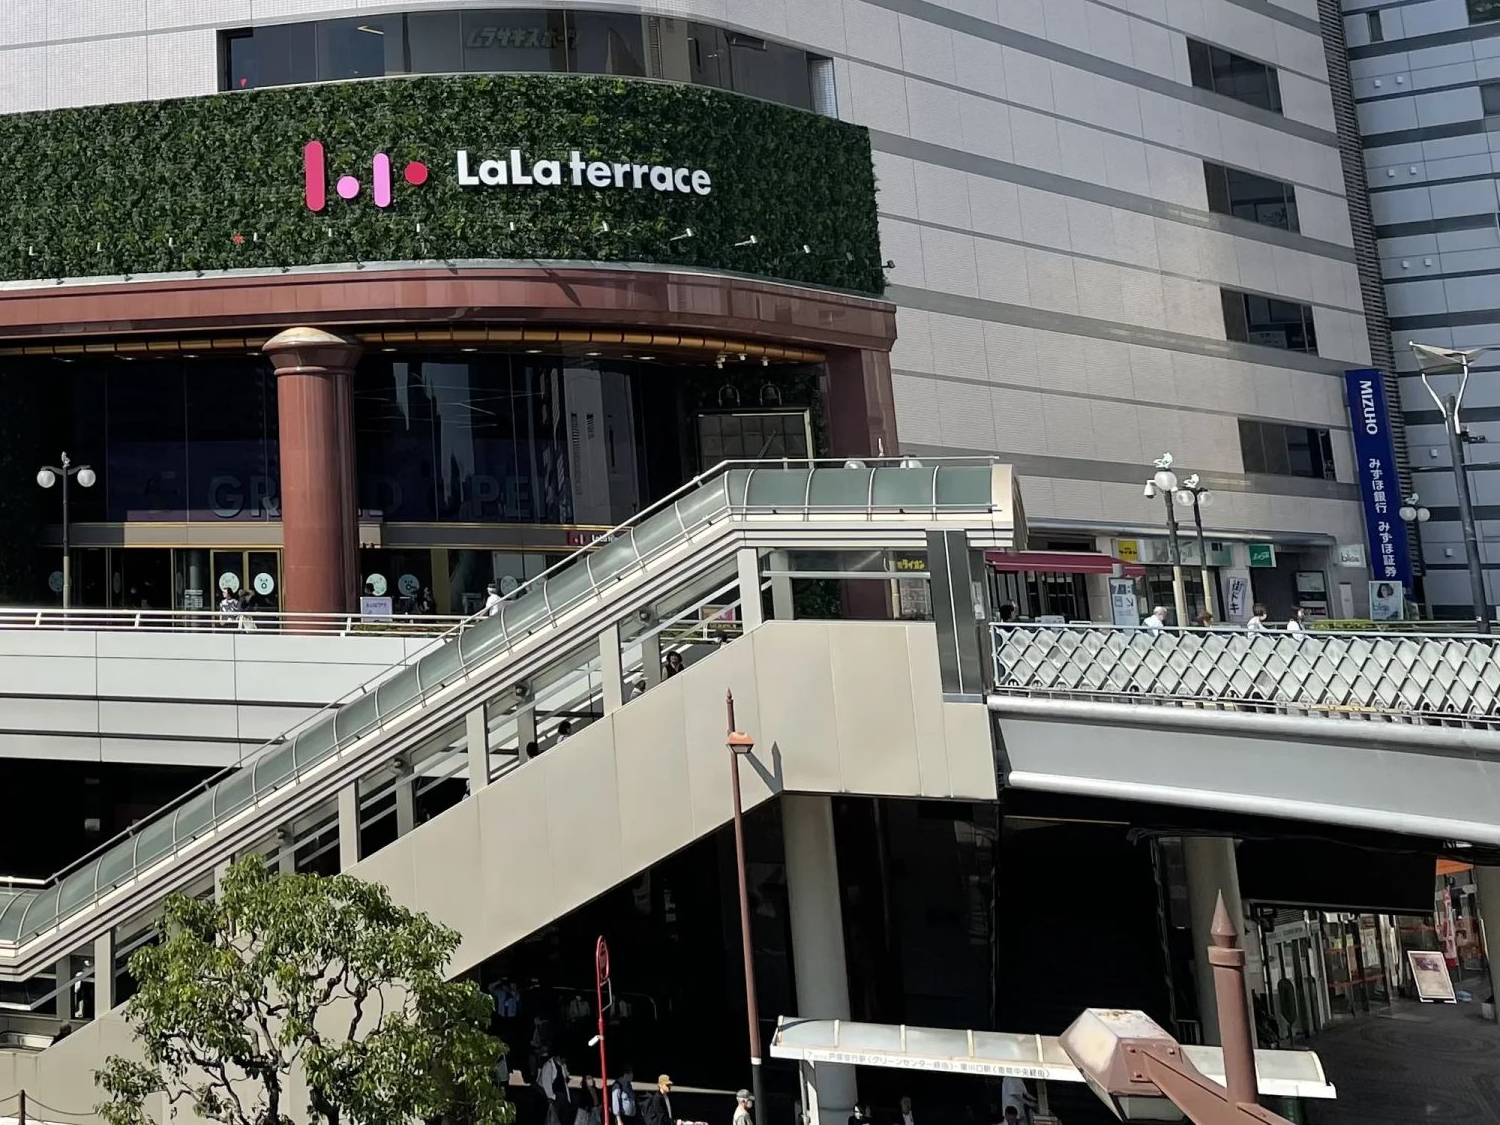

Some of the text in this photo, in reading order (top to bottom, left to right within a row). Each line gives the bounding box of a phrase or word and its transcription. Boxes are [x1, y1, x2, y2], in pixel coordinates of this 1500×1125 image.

[457, 149, 712, 195] LaLa terrace
[1359, 380, 1378, 435] MIZUHO
[1369, 458, 1387, 514] みずほ銀行
[1378, 521, 1397, 577] みずほ証券
